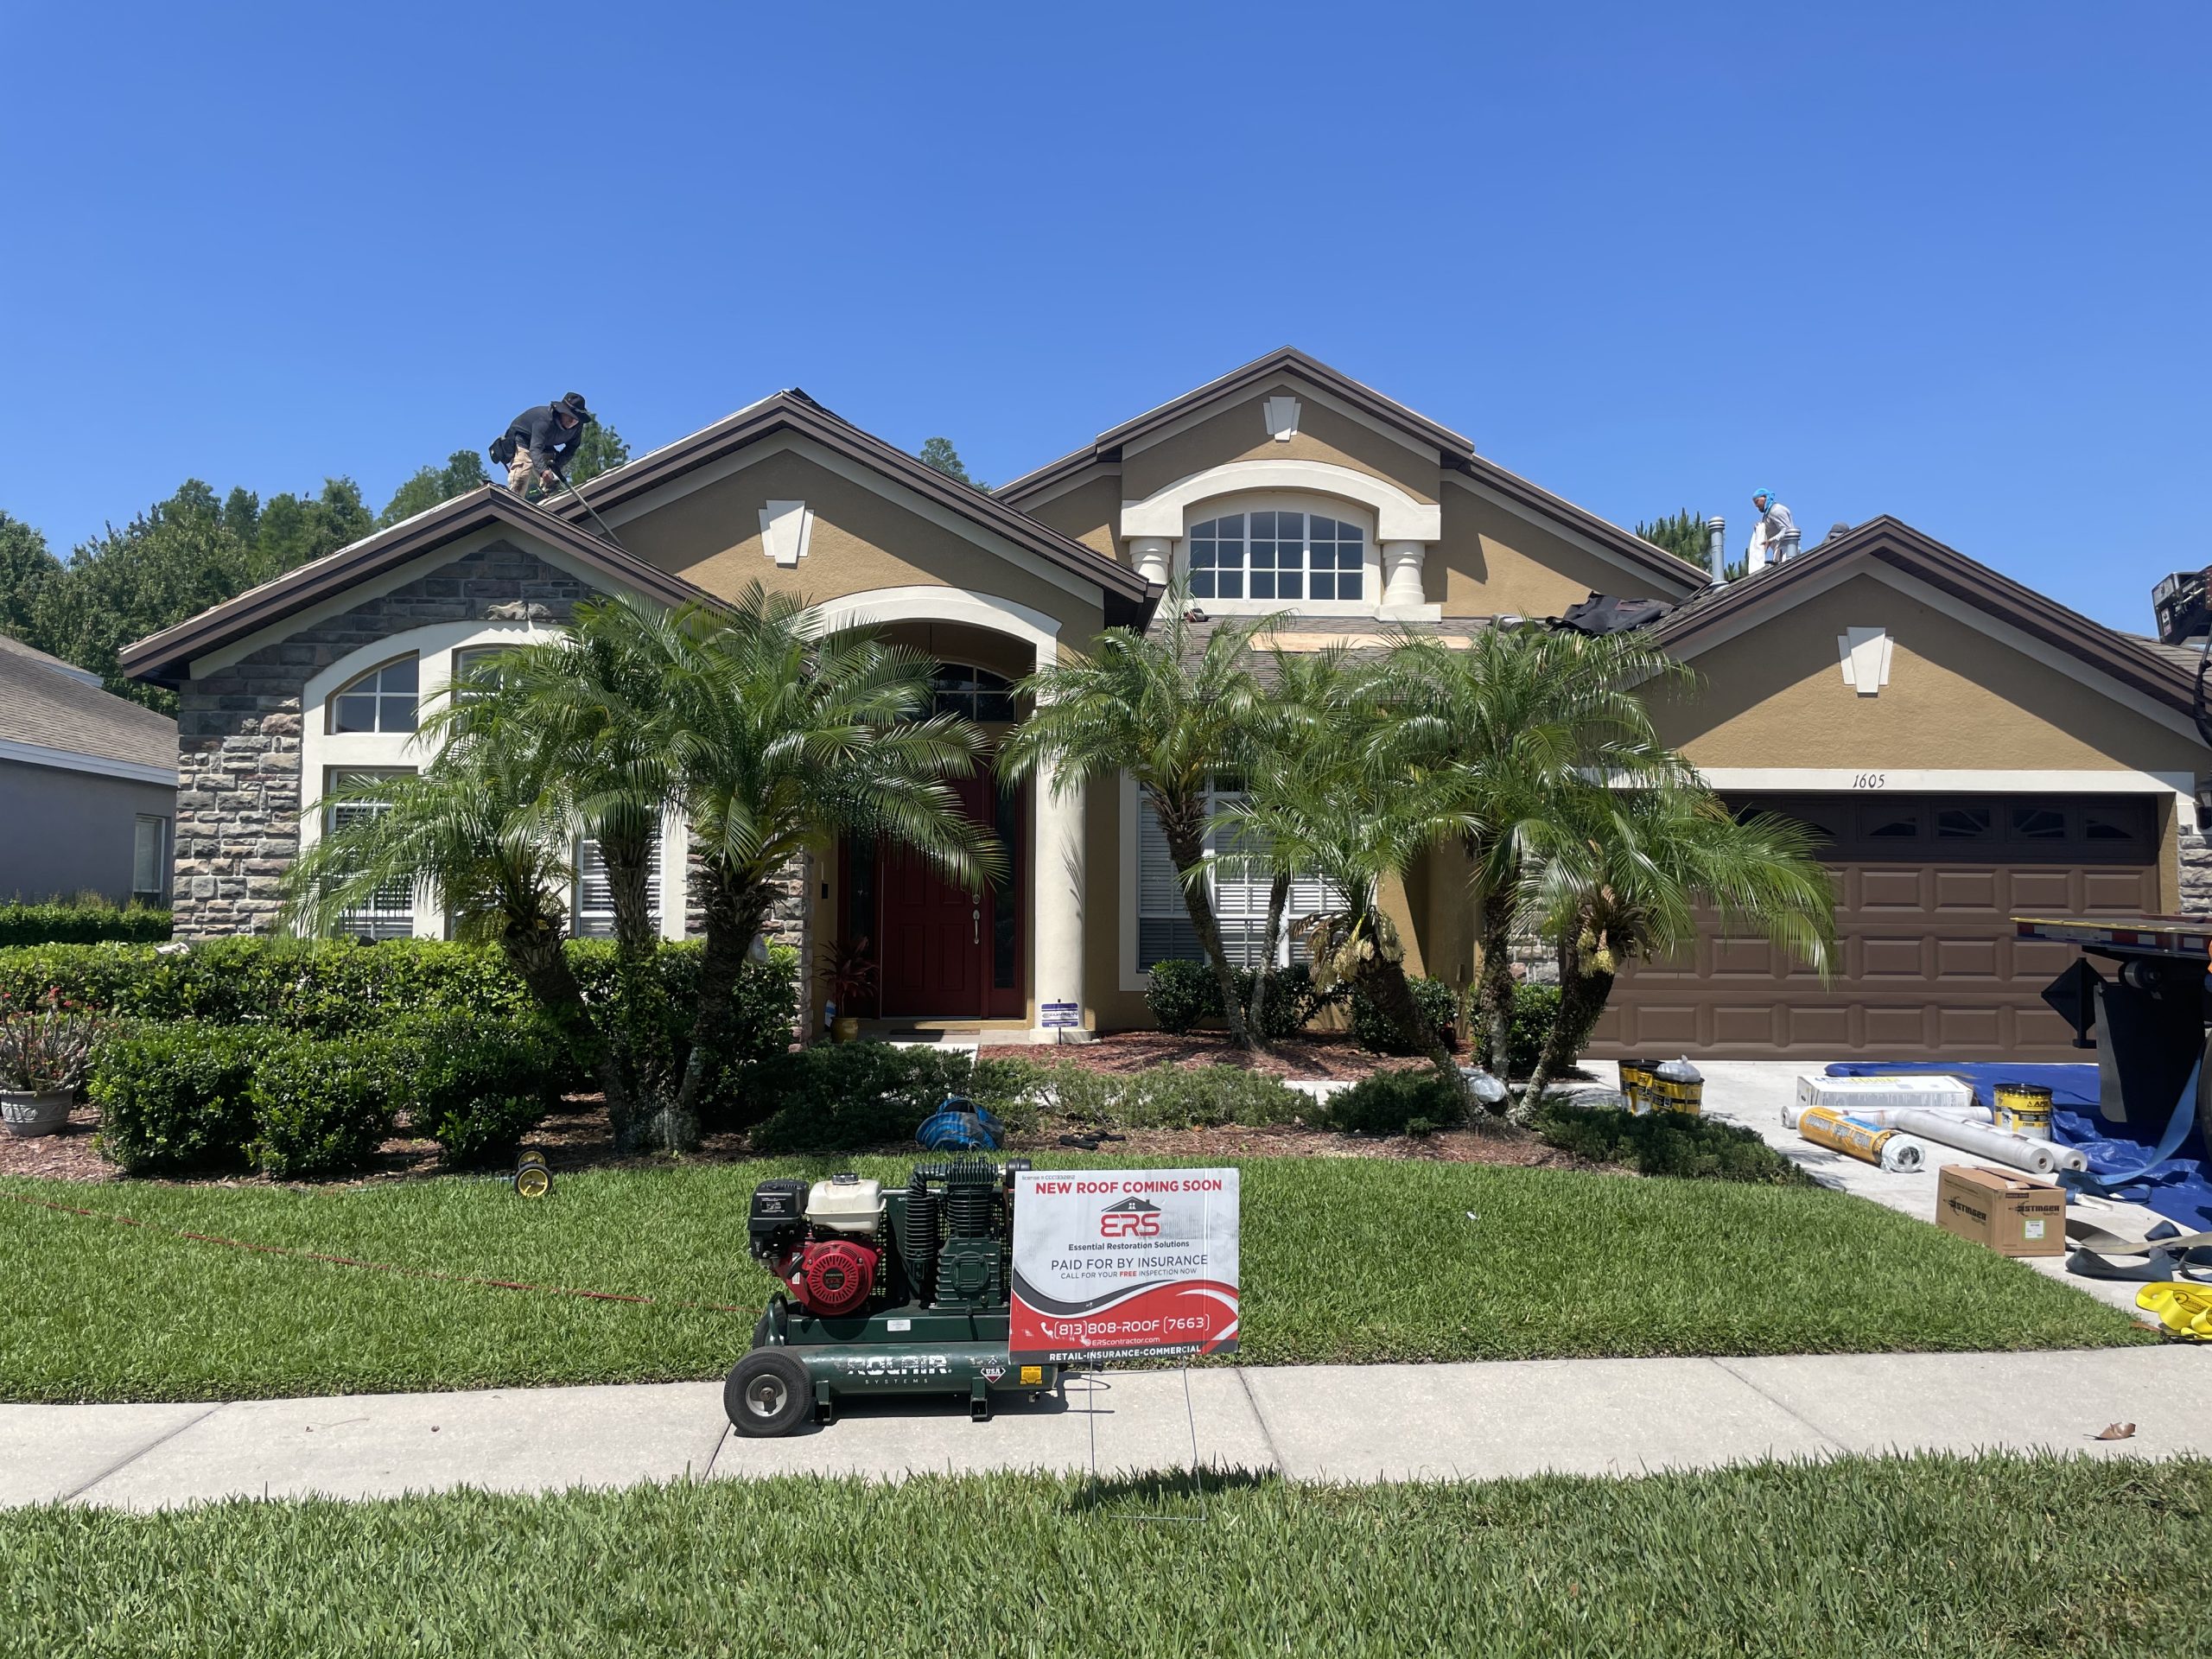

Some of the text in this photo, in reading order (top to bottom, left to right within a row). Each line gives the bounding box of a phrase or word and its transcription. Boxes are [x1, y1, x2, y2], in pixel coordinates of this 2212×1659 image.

[1853, 773, 1885, 788] 1605
[1036, 1179, 1222, 1194] NEW ROOF COMING SOON
[1955, 1202, 1987, 1221] STINGER
[1101, 1213, 1160, 1236] ERS
[1051, 1255, 1208, 1270] PAID FOR BY INSURANCE
[1163, 1313, 1210, 1334] (7663)
[1091, 1337, 1160, 1346] ERScontractor.com
[1049, 1344, 1201, 1361] RETAIL-INSURANCE-COMMERCIAL
